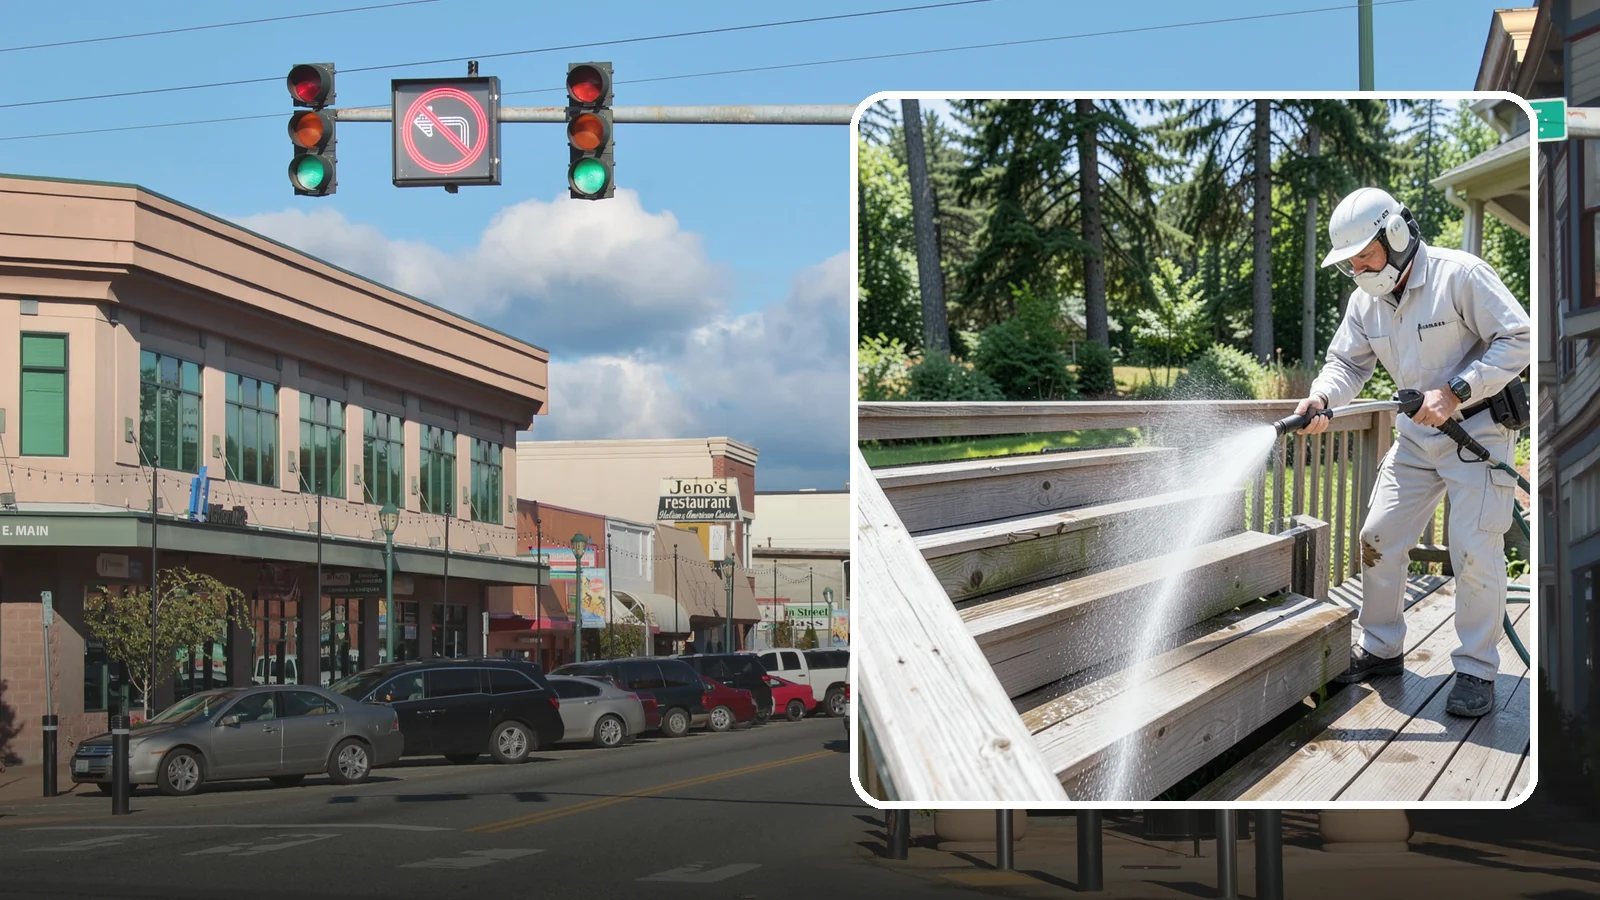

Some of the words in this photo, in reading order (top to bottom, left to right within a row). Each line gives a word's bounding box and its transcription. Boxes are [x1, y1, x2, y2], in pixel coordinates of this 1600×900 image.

[669, 480, 727, 494] Jeno's
[665, 496, 731, 509] restaurant
[658, 510, 681, 520] Italian
[686, 510, 715, 520] American
[715, 509, 738, 520] Cuisine
[2, 525, 13, 536] E.
[15, 525, 49, 536] MAIN
[797, 607, 829, 617] Street
